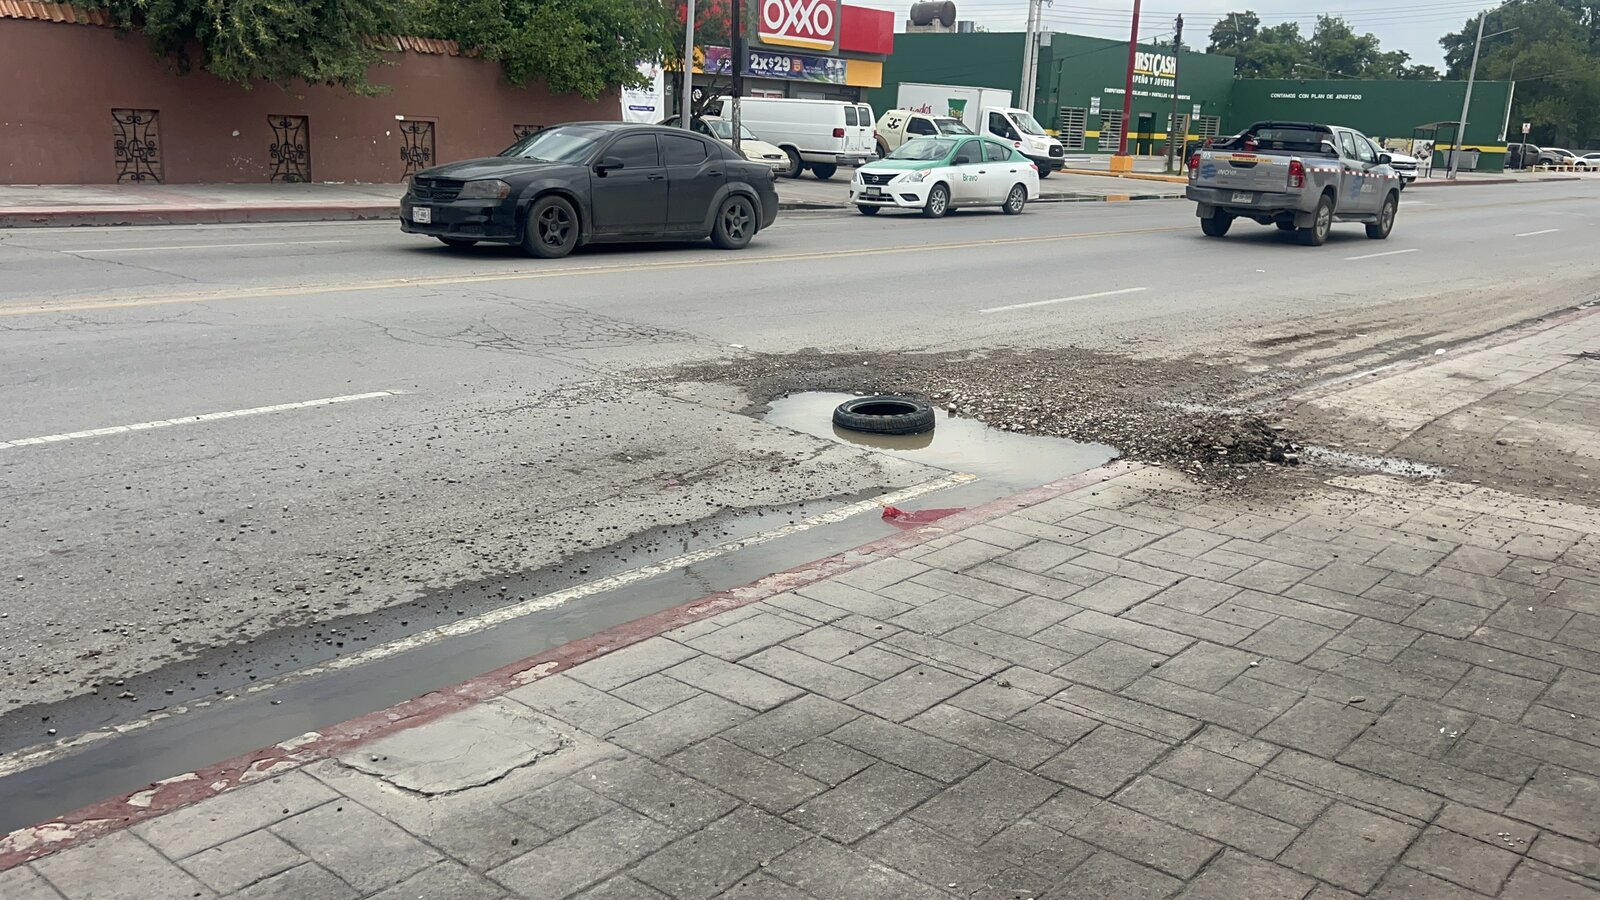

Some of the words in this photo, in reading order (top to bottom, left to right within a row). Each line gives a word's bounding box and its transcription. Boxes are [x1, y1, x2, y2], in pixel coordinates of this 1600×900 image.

[763, 0, 833, 36] OXXO
[1134, 51, 1177, 77] IRSTCASH
[962, 173, 978, 182] Bravo
